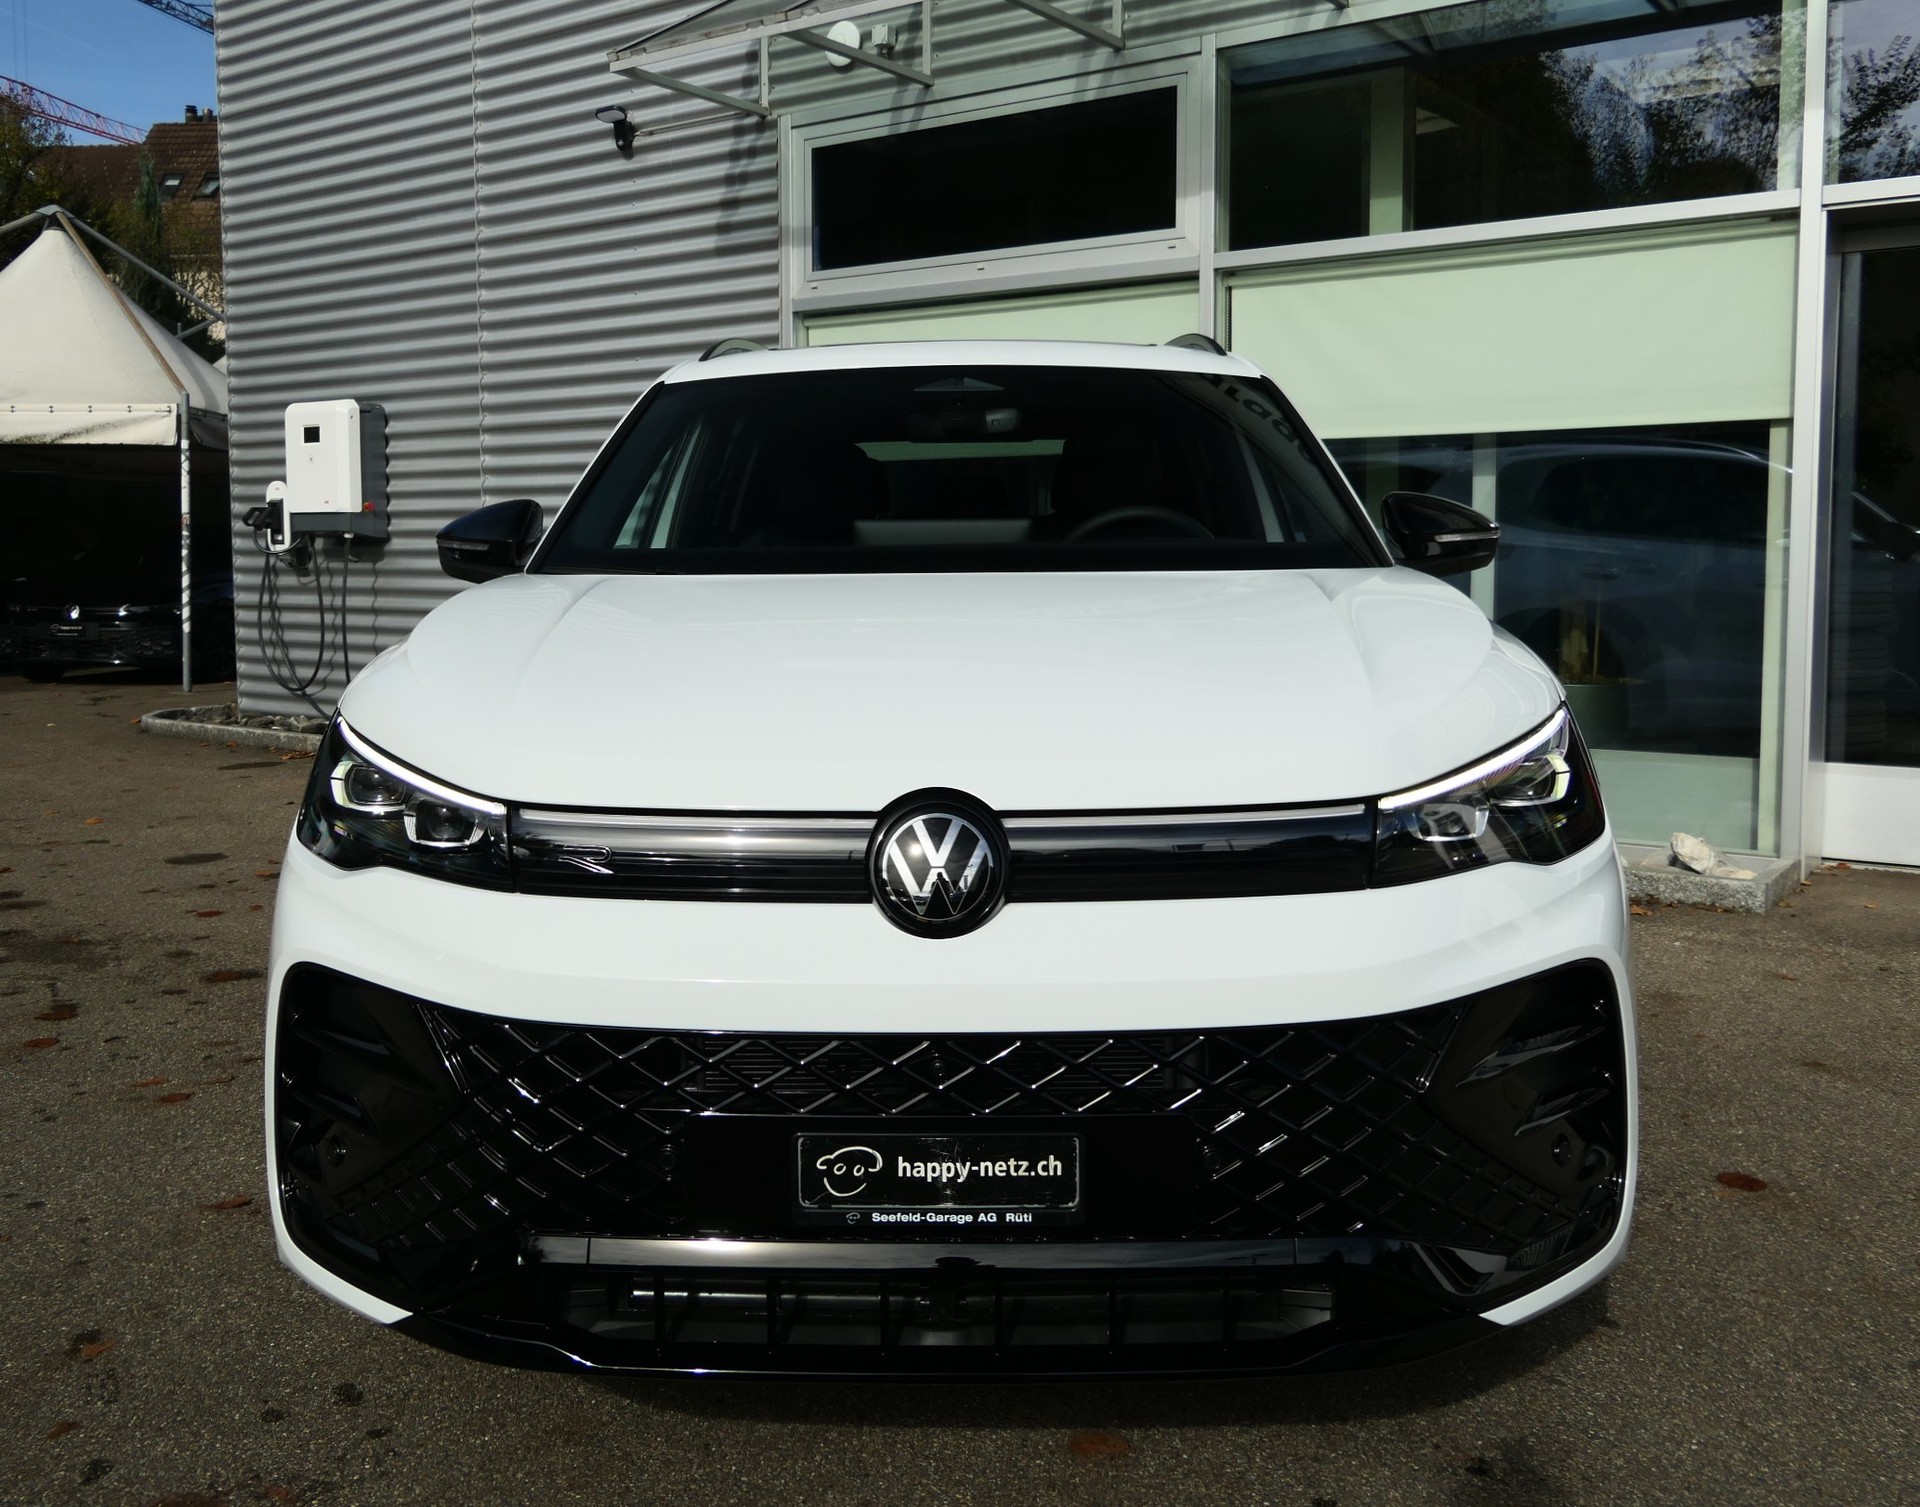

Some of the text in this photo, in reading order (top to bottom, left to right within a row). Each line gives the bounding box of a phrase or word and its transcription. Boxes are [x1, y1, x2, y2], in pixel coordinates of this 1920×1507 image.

[898, 1155, 1062, 1183] happy-netz.ch
[871, 1212, 1033, 1224] Seefeld-Garage AG Rüti
